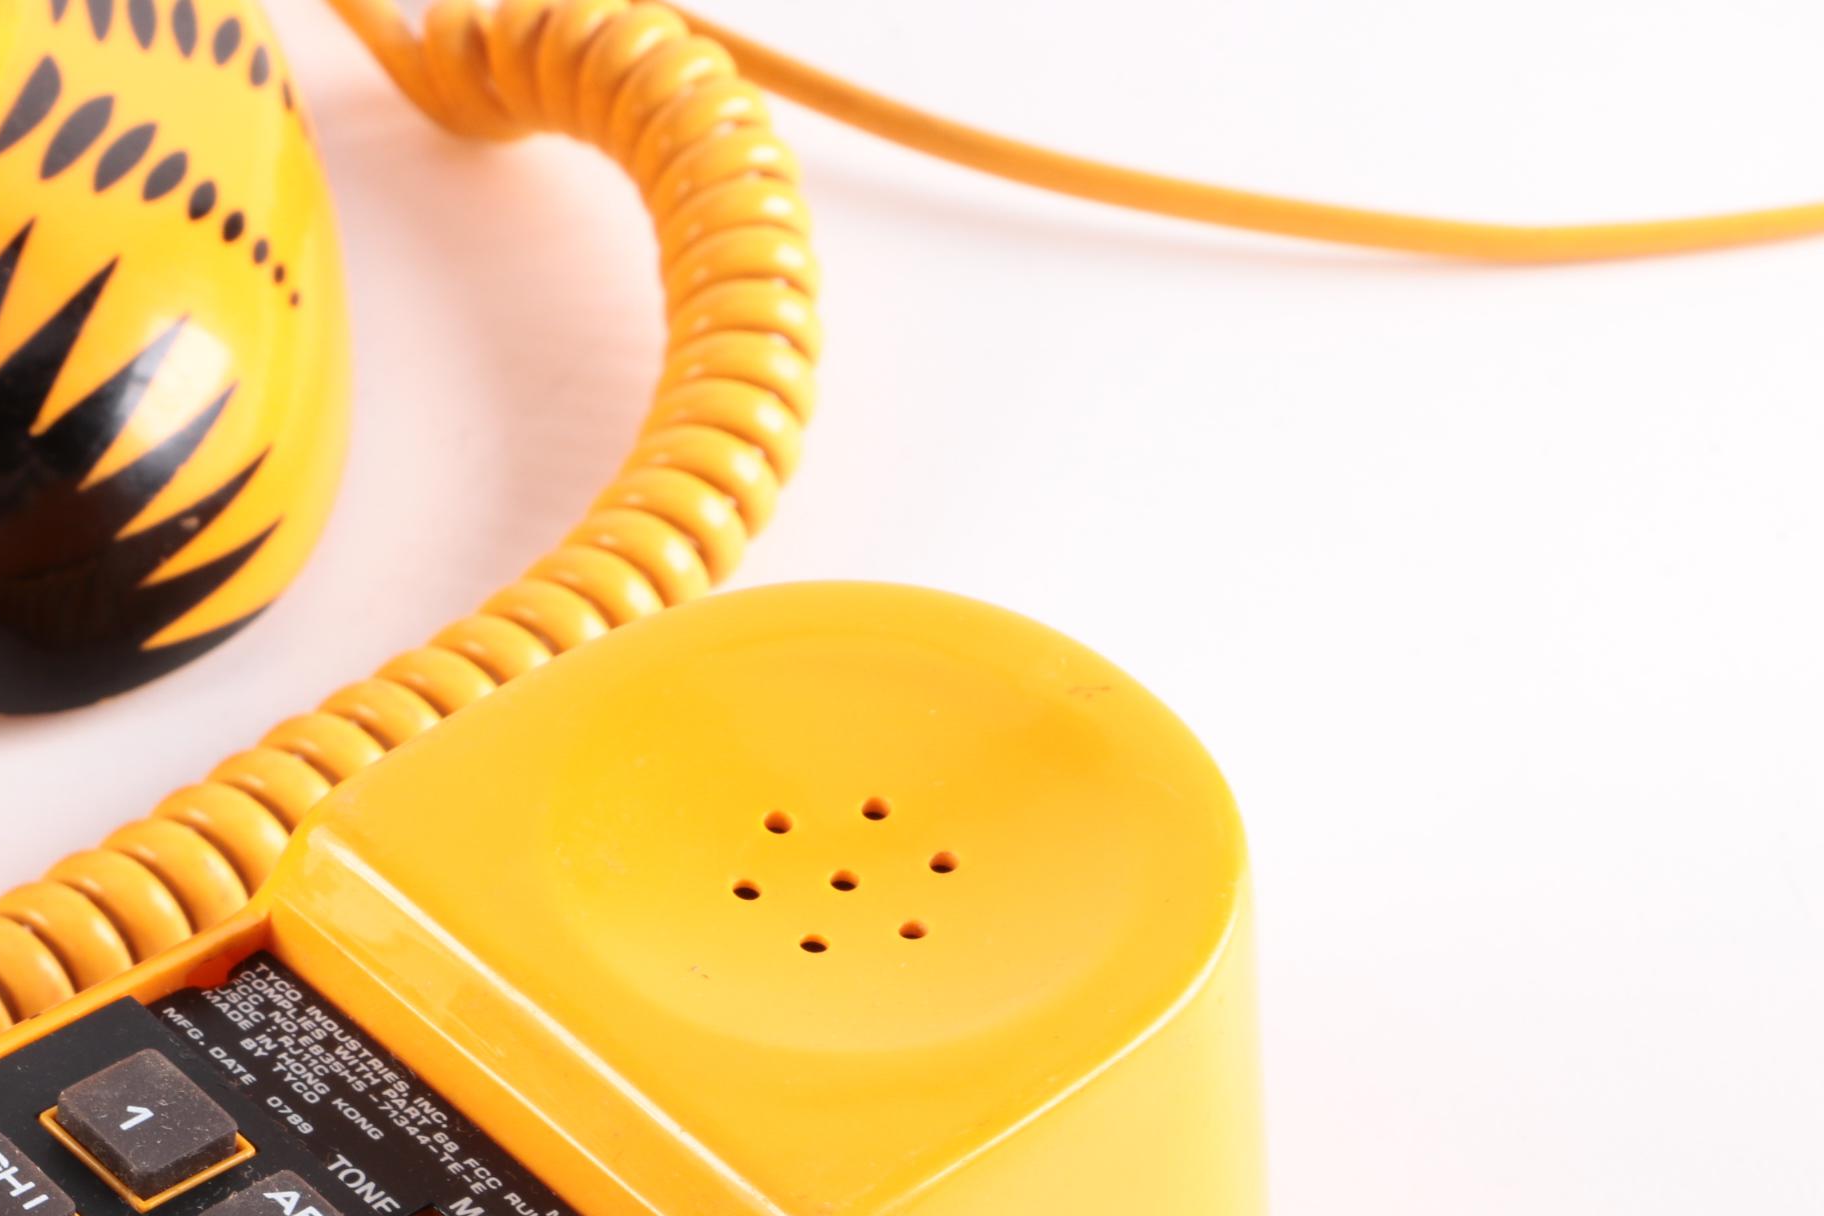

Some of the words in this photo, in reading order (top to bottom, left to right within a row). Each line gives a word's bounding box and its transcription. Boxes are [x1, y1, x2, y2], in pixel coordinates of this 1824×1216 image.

[163, 1007, 205, 1046] MFG.
[208, 1046, 256, 1085] DATE
[266, 1096, 313, 1134] 0789
[201, 989, 255, 1031] MADE
[255, 1034, 277, 1050] IN
[277, 1052, 330, 1094] HONG
[332, 1098, 384, 1139] KONG
[240, 1037, 268, 1056] BY
[272, 1062, 320, 1104] TYCO
[240, 970, 328, 1041] COMPLIES
[334, 1045, 381, 1085] WITH
[382, 1088, 431, 1125] PART
[433, 1132, 459, 1153] 68
[462, 1158, 502, 1189] FCC
[256, 963, 303, 1002] TYCO
[305, 1005, 409, 1097] INDUSTRIES,
[413, 1097, 447, 1128] INC.
[119, 1105, 155, 1131] 1
[327, 1153, 401, 1214] TONE
